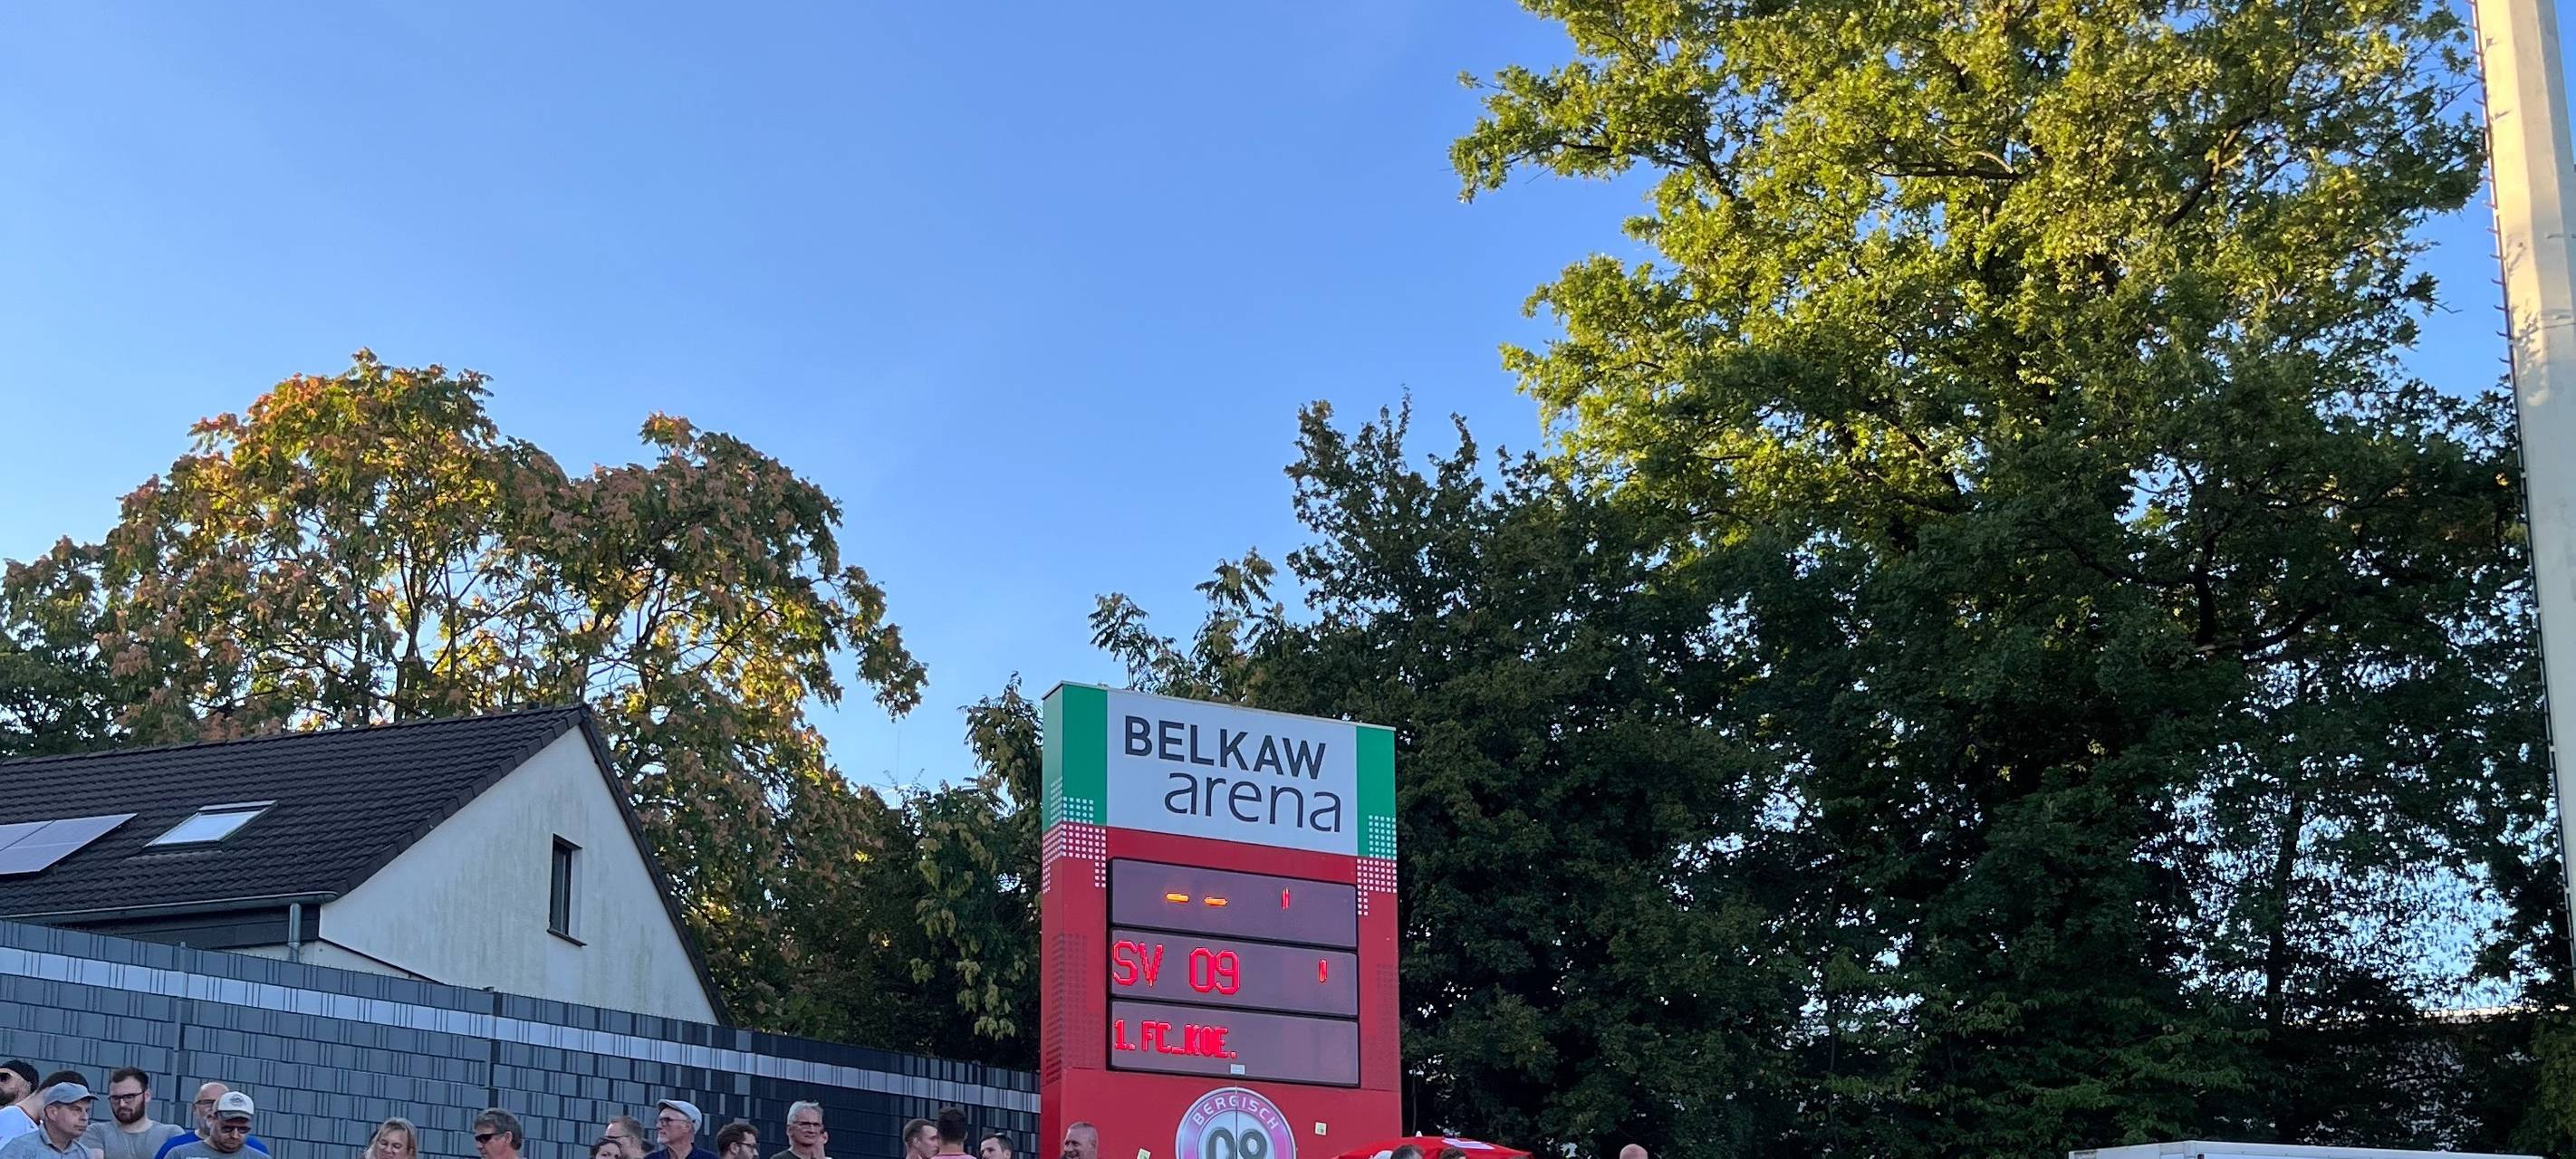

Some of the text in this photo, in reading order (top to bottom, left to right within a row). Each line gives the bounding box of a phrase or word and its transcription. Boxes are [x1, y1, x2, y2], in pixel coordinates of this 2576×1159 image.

[1124, 714, 1326, 780] BELKAW
[1164, 772, 1341, 833] arena
[1113, 940, 1164, 987] SV
[1188, 946, 1241, 995] 09
[1192, 1095, 1279, 1130] BERGISCH
